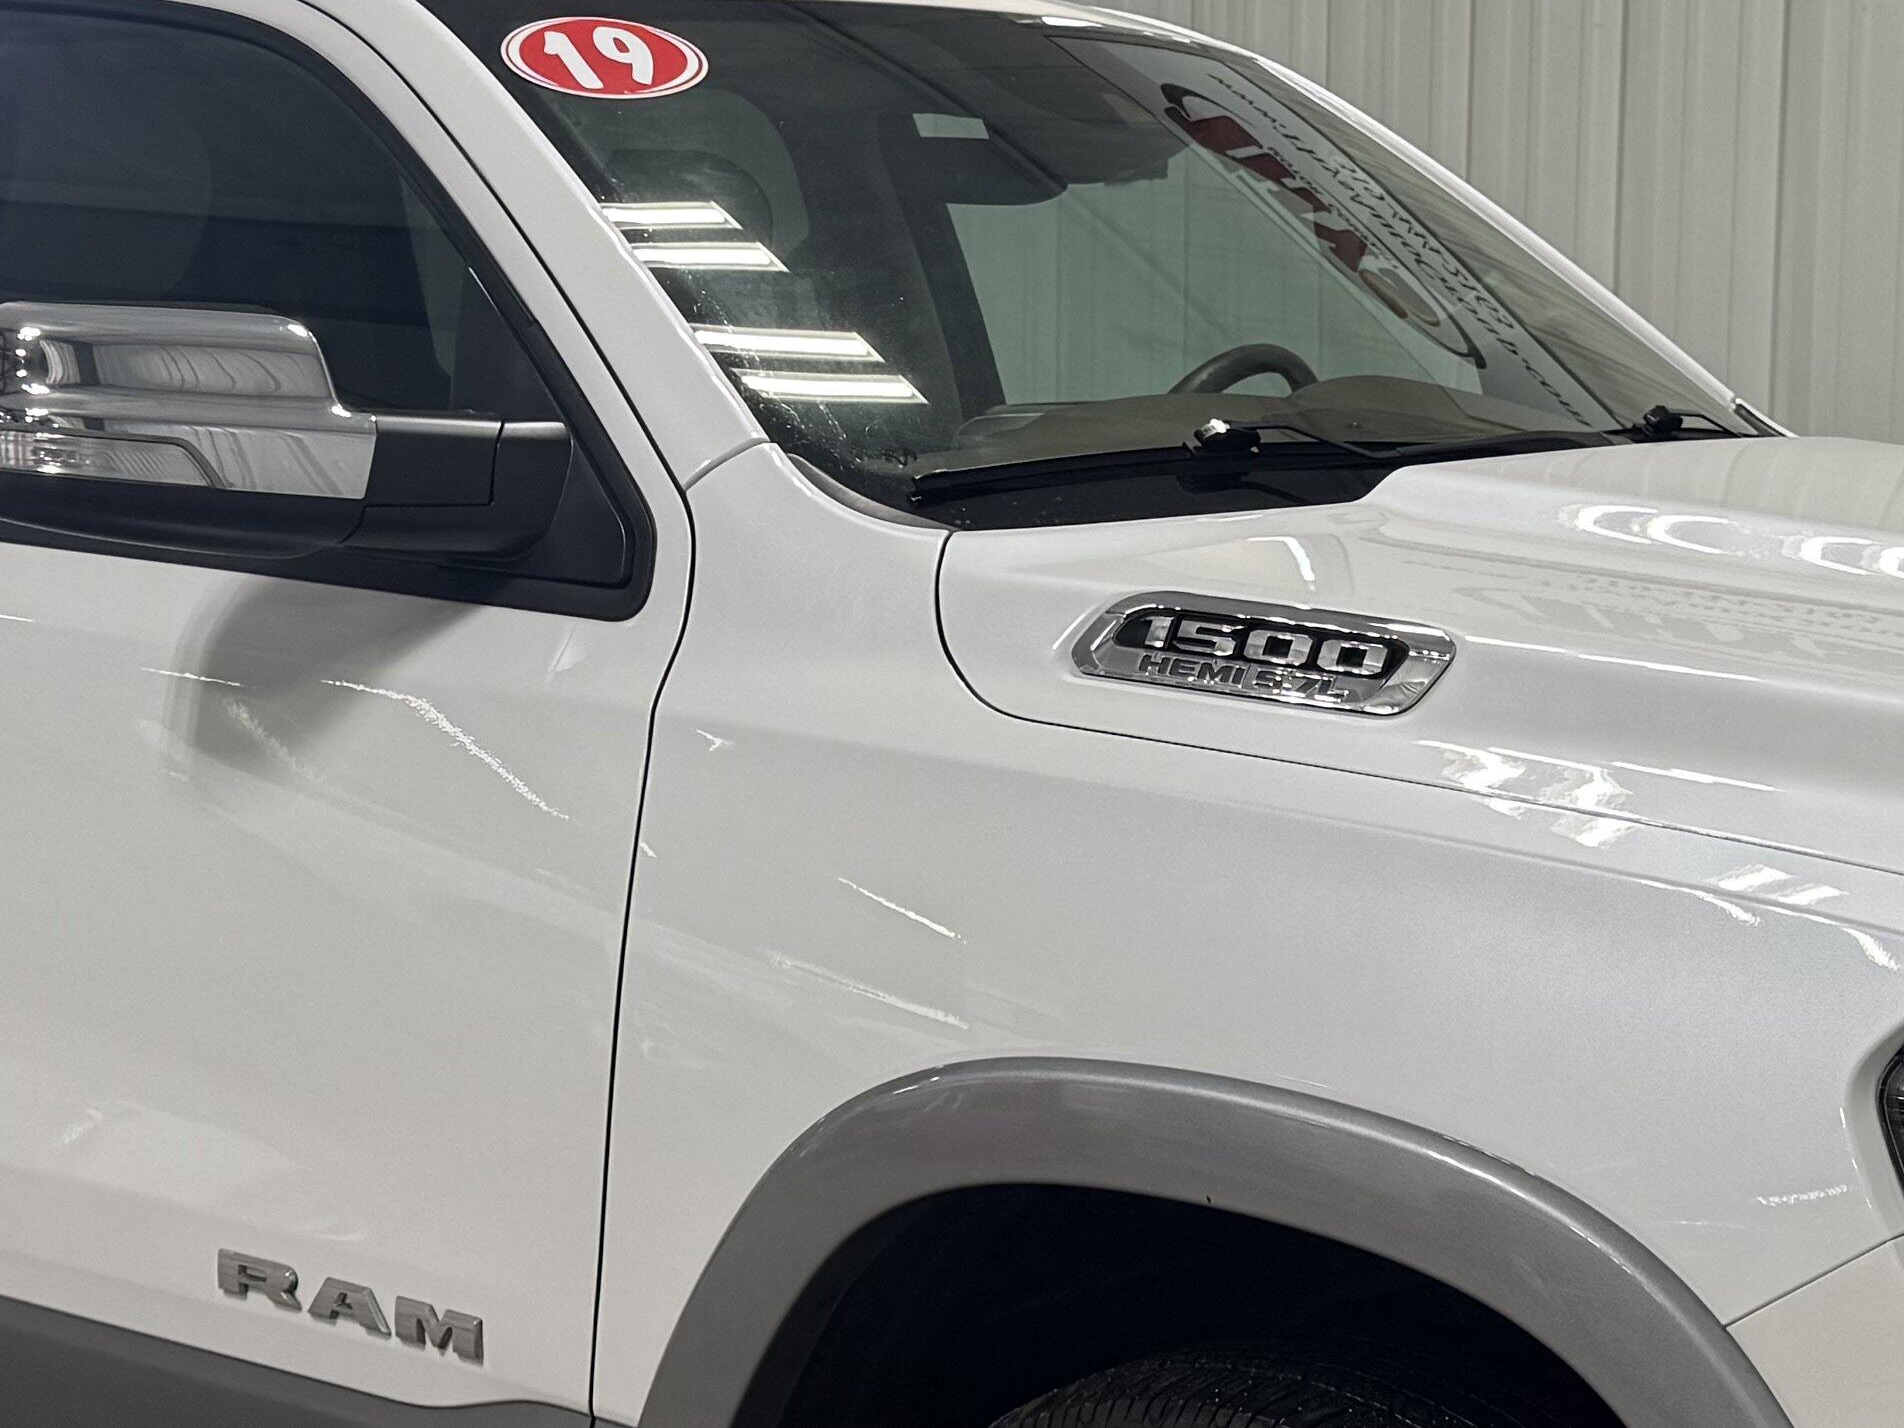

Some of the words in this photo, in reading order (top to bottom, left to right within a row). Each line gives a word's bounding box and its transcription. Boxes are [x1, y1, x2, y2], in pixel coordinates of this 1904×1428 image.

[544, 26, 653, 89] 19
[1139, 653, 1246, 689] HEMI
[1143, 615, 1388, 676] 1500
[217, 1248, 484, 1367] RAM
